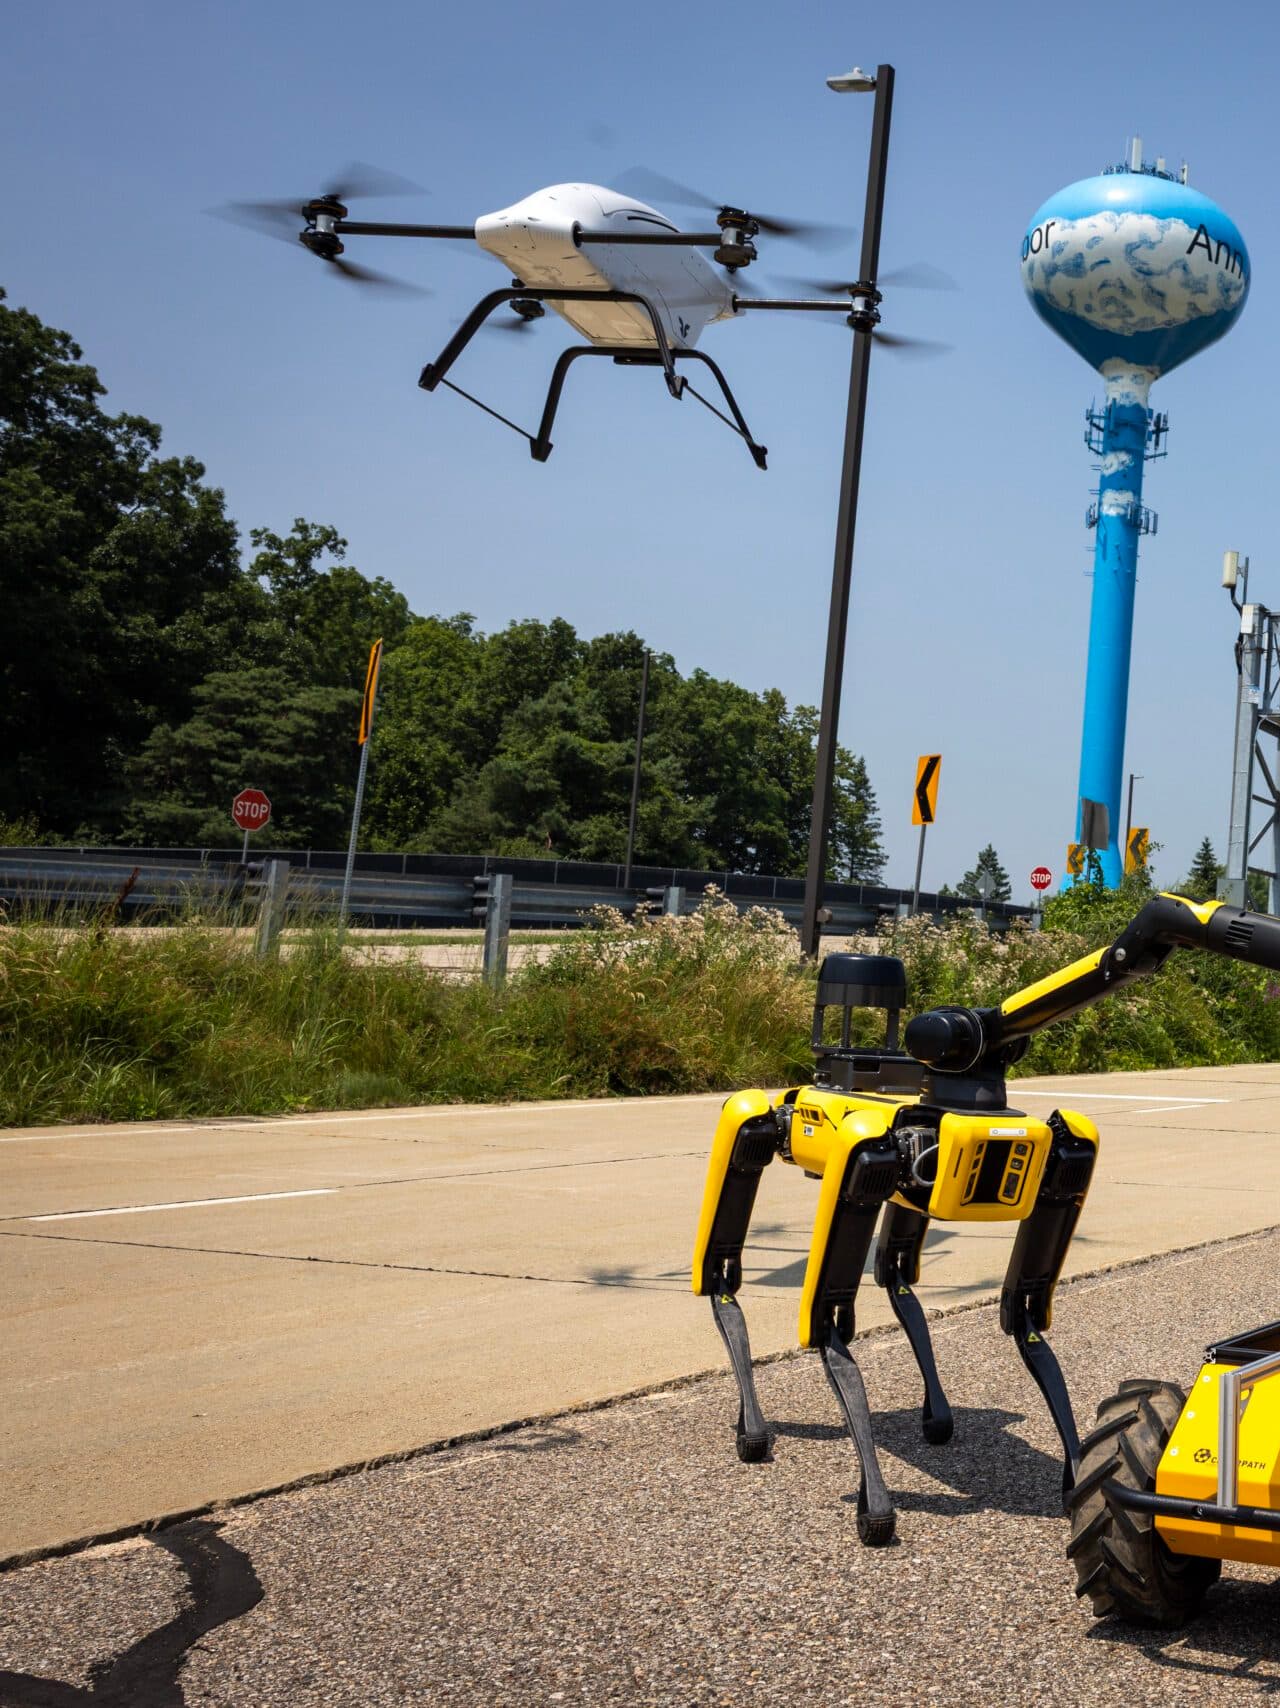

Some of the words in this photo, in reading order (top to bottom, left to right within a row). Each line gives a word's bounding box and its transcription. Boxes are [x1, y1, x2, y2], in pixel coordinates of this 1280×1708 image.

[1185, 223, 1244, 280] Ann
[235, 800, 269, 819] STOP
[1031, 873, 1051, 884] STOP
[1210, 1456, 1267, 1470] CPATH
